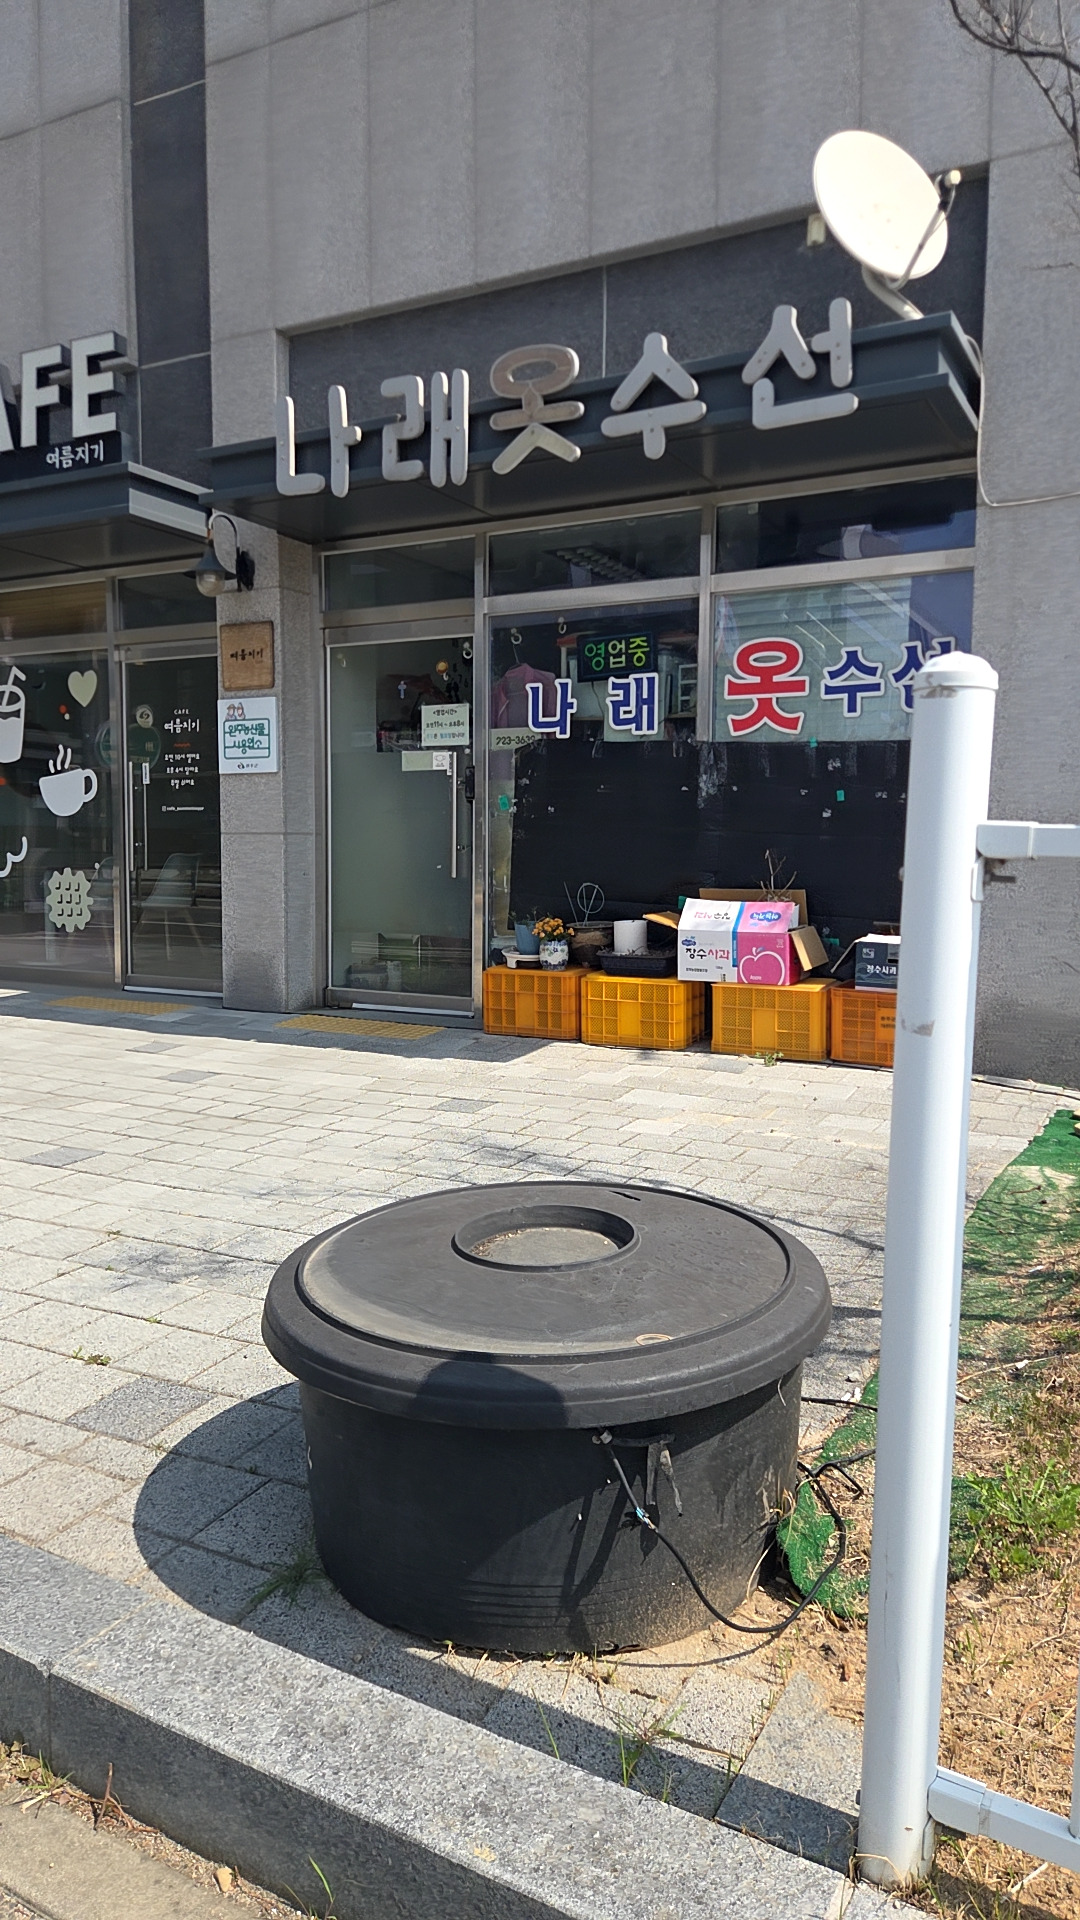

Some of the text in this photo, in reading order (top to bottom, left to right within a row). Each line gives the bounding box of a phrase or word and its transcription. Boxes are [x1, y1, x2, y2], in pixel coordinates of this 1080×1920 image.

[46, 440, 104, 469] 여름지기
[585, 637, 651, 671] 영업중
[164, 718, 199, 733] 여름지기
[228, 722, 265, 737] 완주농산물
[232, 737, 263, 754] 사용업소
[685, 947, 730, 960] 장수사과
